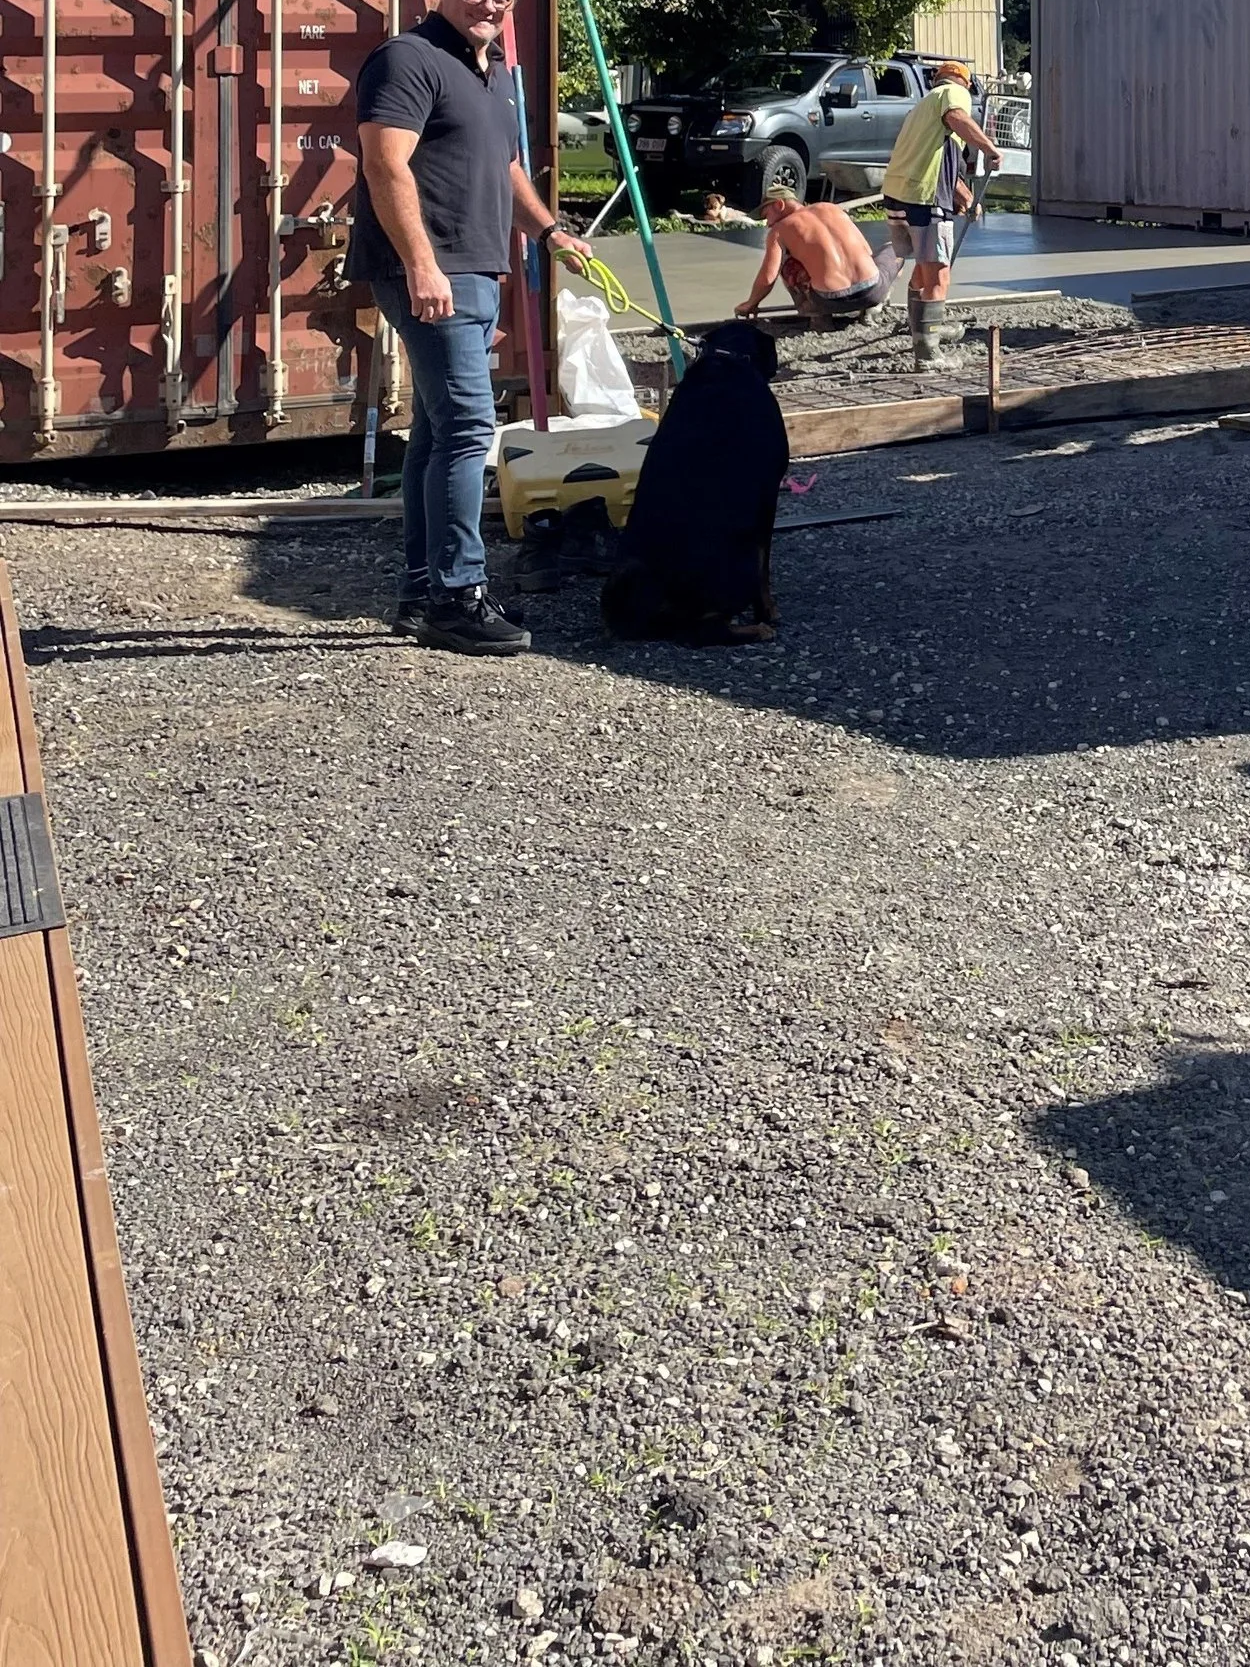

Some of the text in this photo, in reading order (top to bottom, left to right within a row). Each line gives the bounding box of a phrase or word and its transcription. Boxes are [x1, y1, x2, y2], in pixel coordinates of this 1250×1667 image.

[300, 25, 326, 40] TARE
[298, 80, 320, 95] NET
[296, 136, 315, 150] CU.
